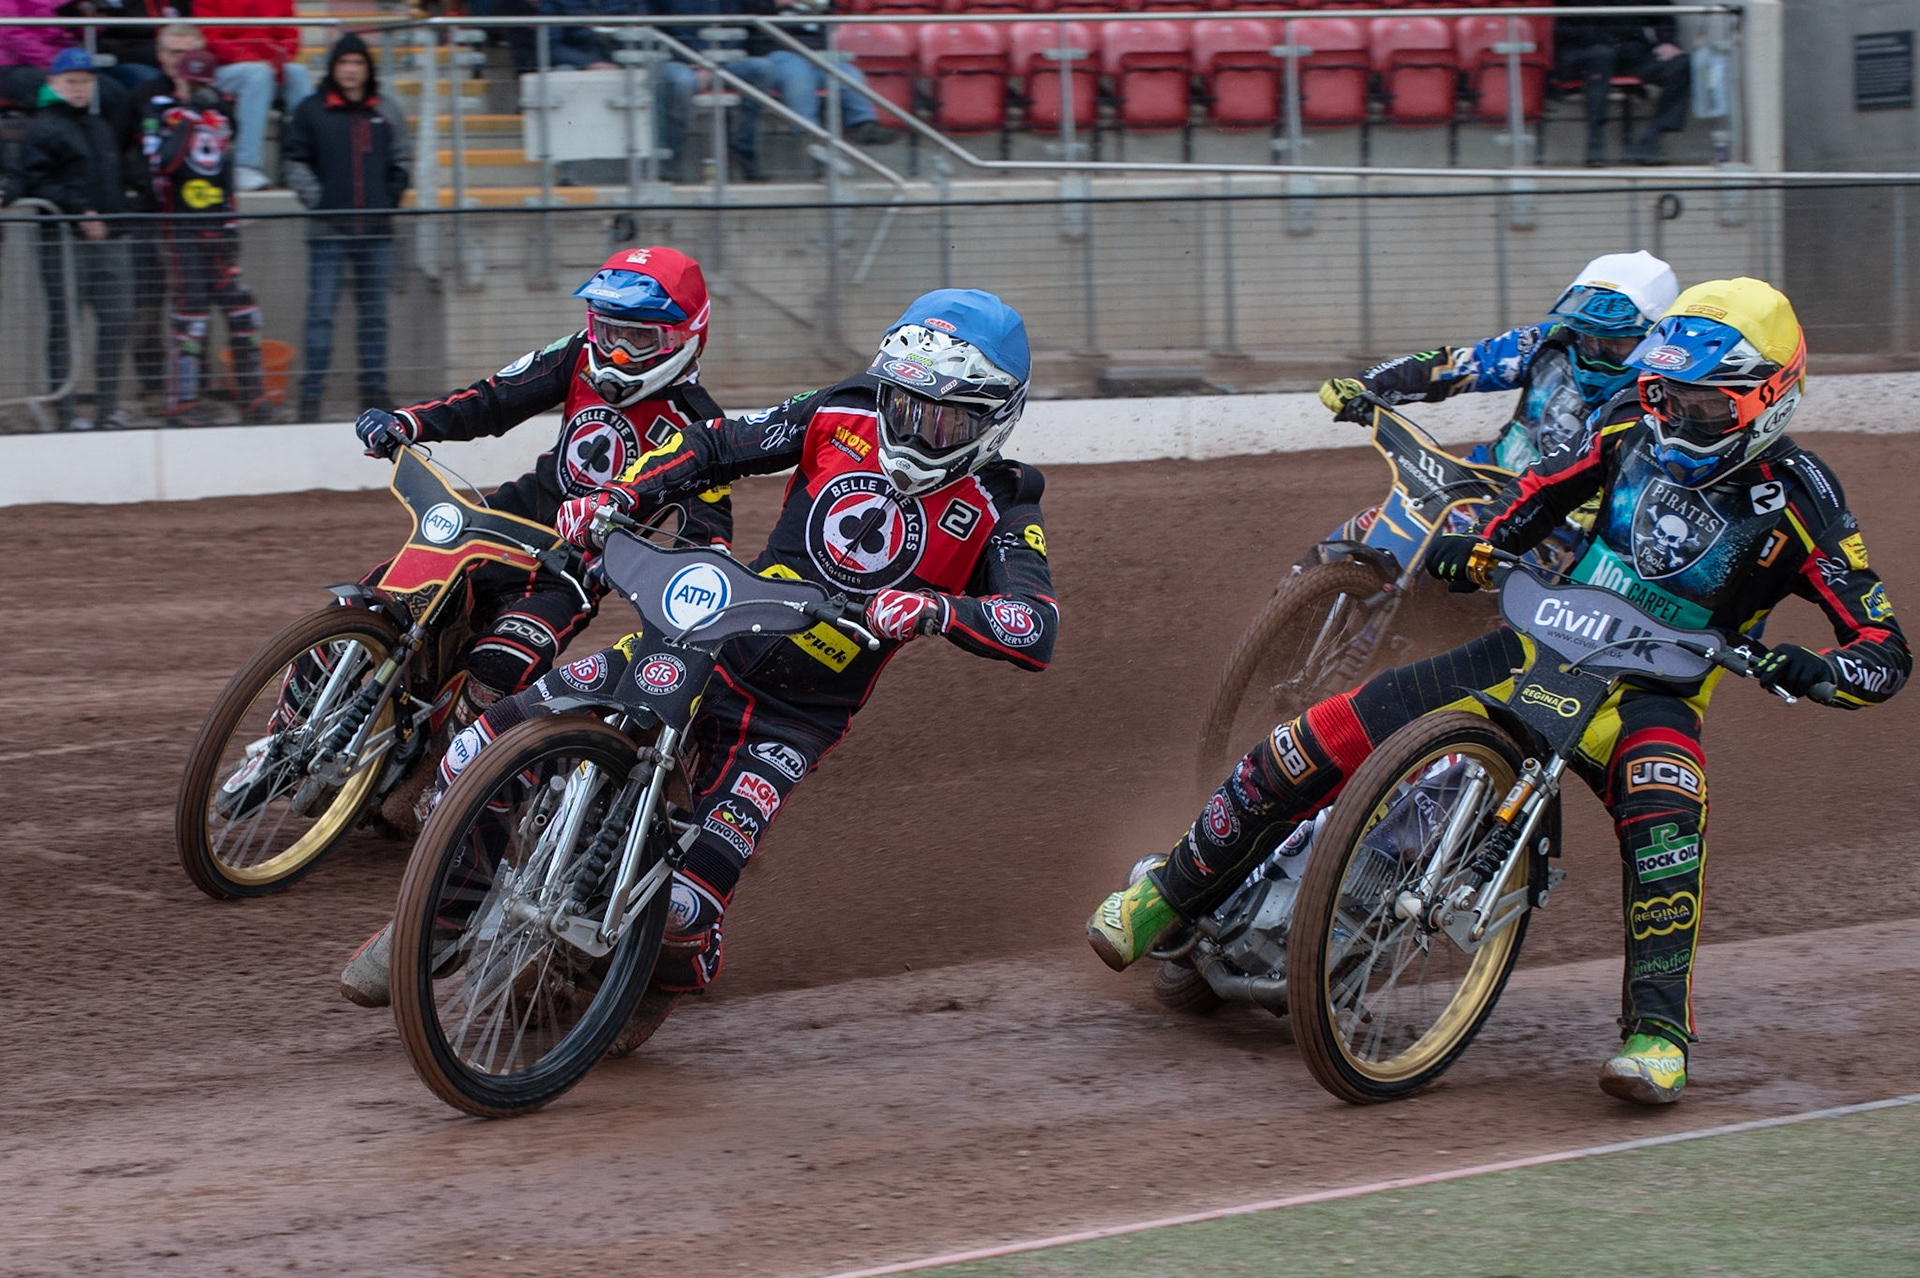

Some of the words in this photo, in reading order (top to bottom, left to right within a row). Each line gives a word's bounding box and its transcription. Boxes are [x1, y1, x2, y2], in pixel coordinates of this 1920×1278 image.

[1648, 351, 1684, 363] STS
[893, 362, 927, 380] STS
[575, 411, 606, 426] BELLE
[1651, 484, 1720, 534] PIRATES
[1753, 484, 1780, 510] 2
[428, 511, 455, 535] ATPI
[831, 479, 878, 498] BELLE
[905, 513, 920, 551] ACES
[944, 504, 973, 535] 2
[674, 584, 716, 609] ATPI
[1628, 582, 1684, 624] CARPET
[999, 607, 1026, 629] STS
[802, 630, 848, 666] ruck
[1004, 631, 1039, 644] SERVICES
[647, 664, 673, 683] STS
[1522, 687, 1560, 707] REGINA
[454, 738, 470, 764] ATPI
[739, 774, 779, 807] NGK
[1632, 762, 1699, 795] JCB
[1638, 854, 1677, 874] ROCK
[1679, 846, 1697, 863] OIL
[668, 900, 690, 918] TPI
[1634, 904, 1689, 922] REGINA
